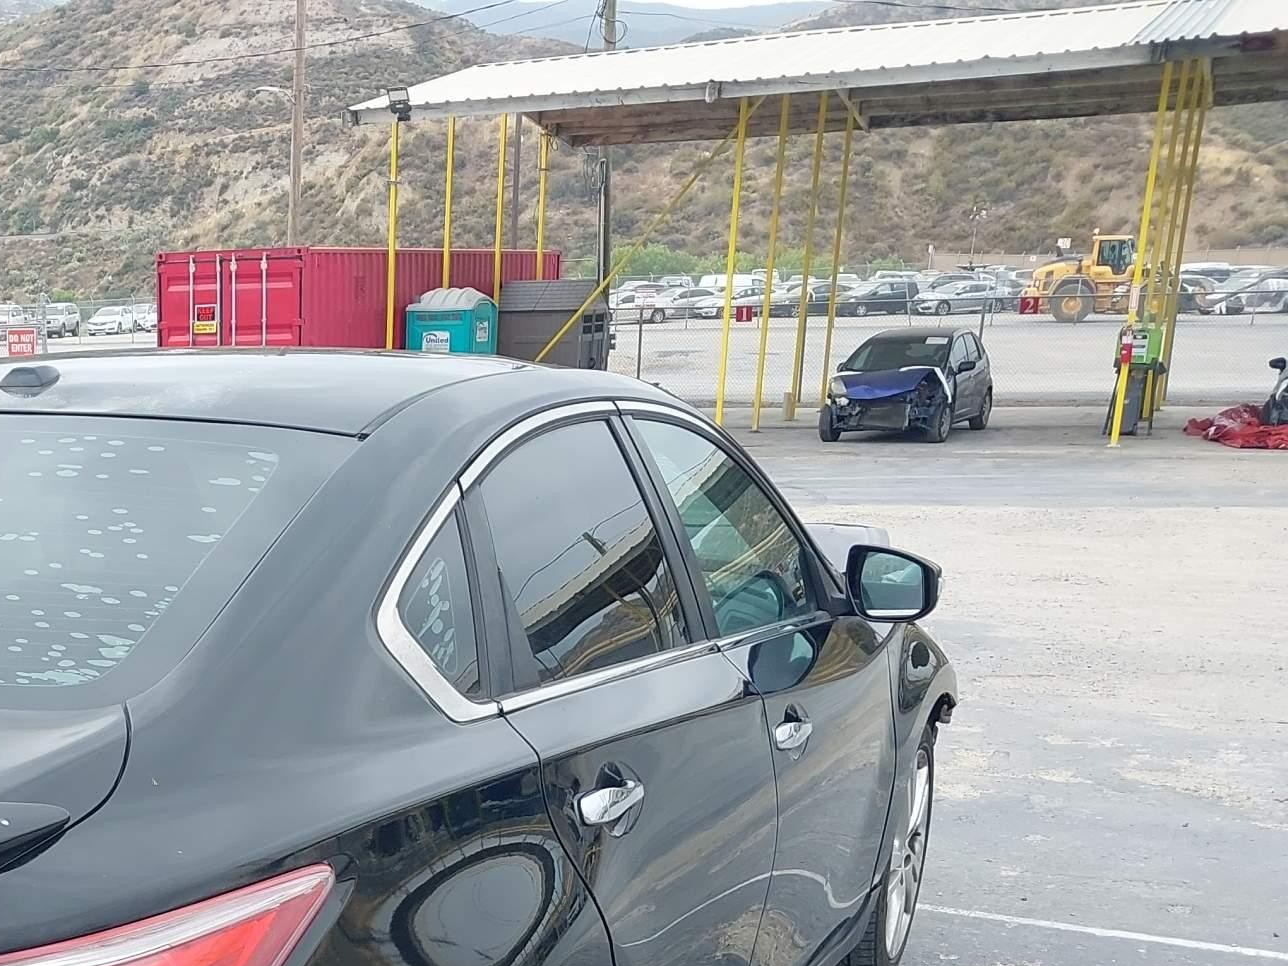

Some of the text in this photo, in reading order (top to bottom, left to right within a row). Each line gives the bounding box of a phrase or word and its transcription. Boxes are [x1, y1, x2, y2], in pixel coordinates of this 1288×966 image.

[1024, 298, 1034, 313] 2
[9, 333, 34, 343] DO NOT
[425, 336, 449, 344] United
[12, 344, 32, 353] ENTER
